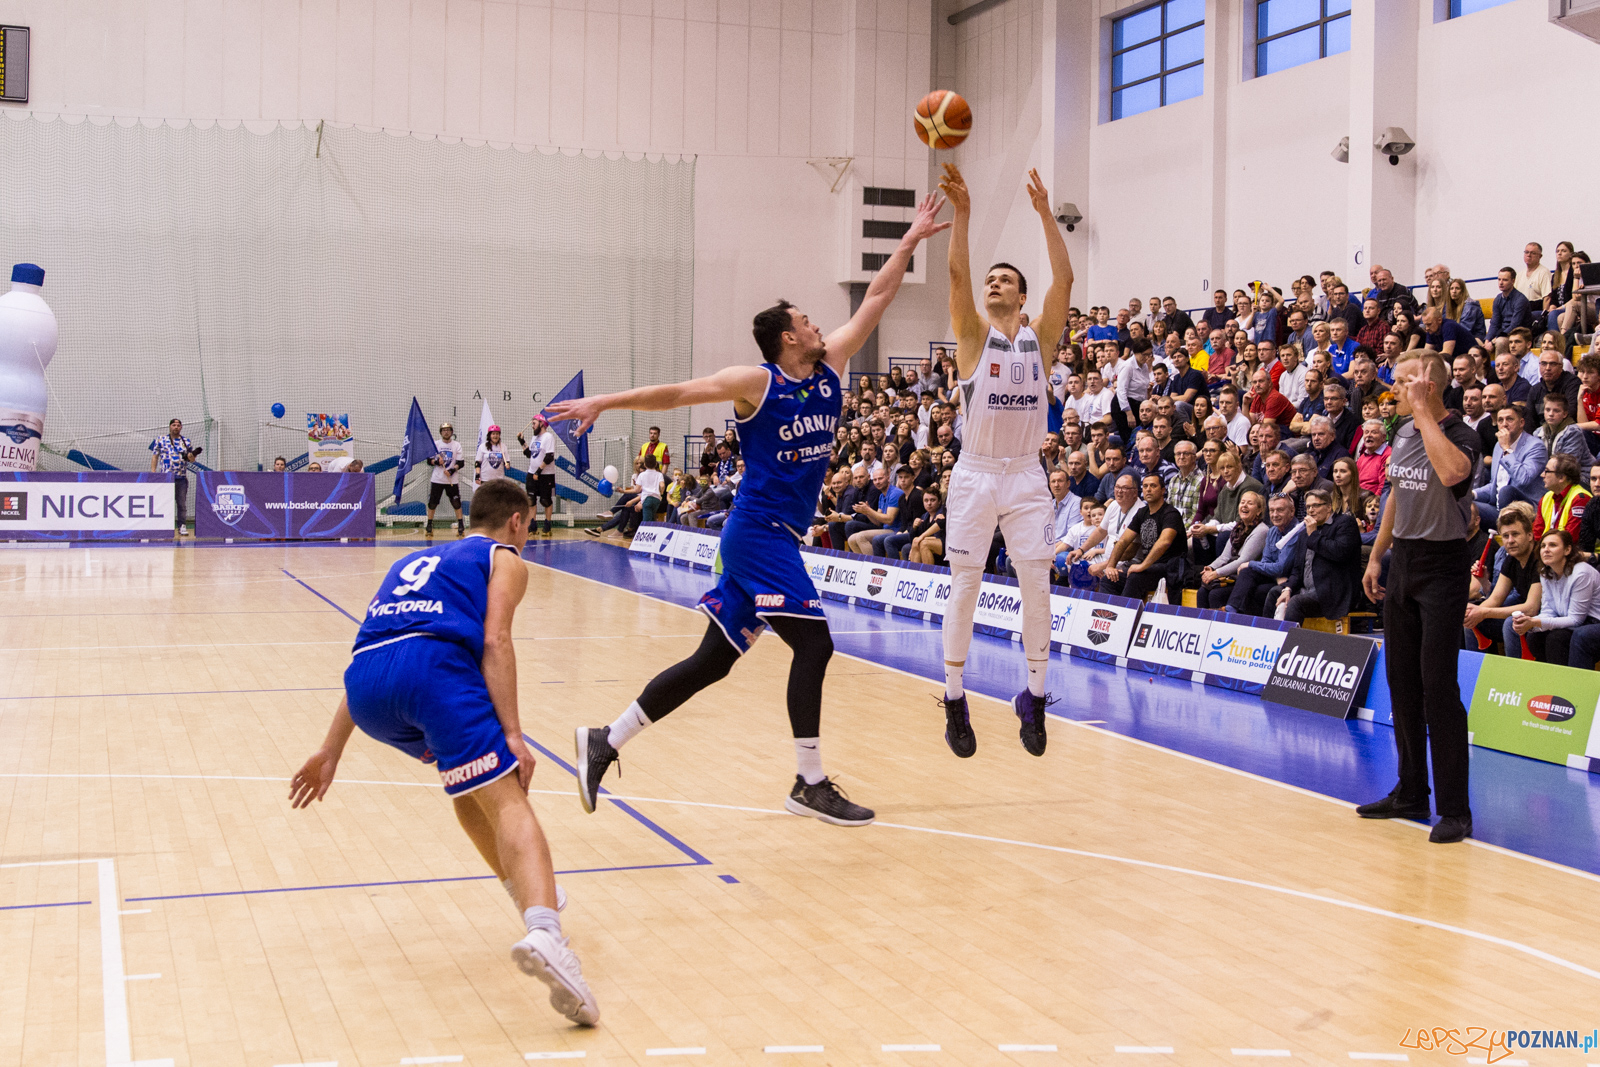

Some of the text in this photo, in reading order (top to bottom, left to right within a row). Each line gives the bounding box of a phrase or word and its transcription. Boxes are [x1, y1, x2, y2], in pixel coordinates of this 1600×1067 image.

[1203, 279, 1209, 292] D
[1011, 362, 1024, 384] 0
[473, 389, 542, 403] A B C
[818, 379, 832, 398] 6
[779, 414, 837, 441] GÓRNIK
[1399, 480, 1427, 491] active
[42, 495, 165, 518] NICKEL
[265, 501, 362, 511] www.basket.poznan.pl
[392, 556, 441, 596] 9
[832, 568, 857, 586] NICKEL
[371, 599, 444, 618] VICTORIA
[977, 592, 1021, 615] BIOFARM
[1091, 619, 1111, 632] JOKER
[1151, 628, 1201, 656] NICKEL
[1227, 656, 1275, 670] biuro podró
[1276, 645, 1360, 690] drukma
[1271, 675, 1352, 702] DRUKARNIA SKOCZYŃSKI
[1487, 688, 1522, 707] Frytki
[1530, 700, 1574, 715] FARM FRITES
